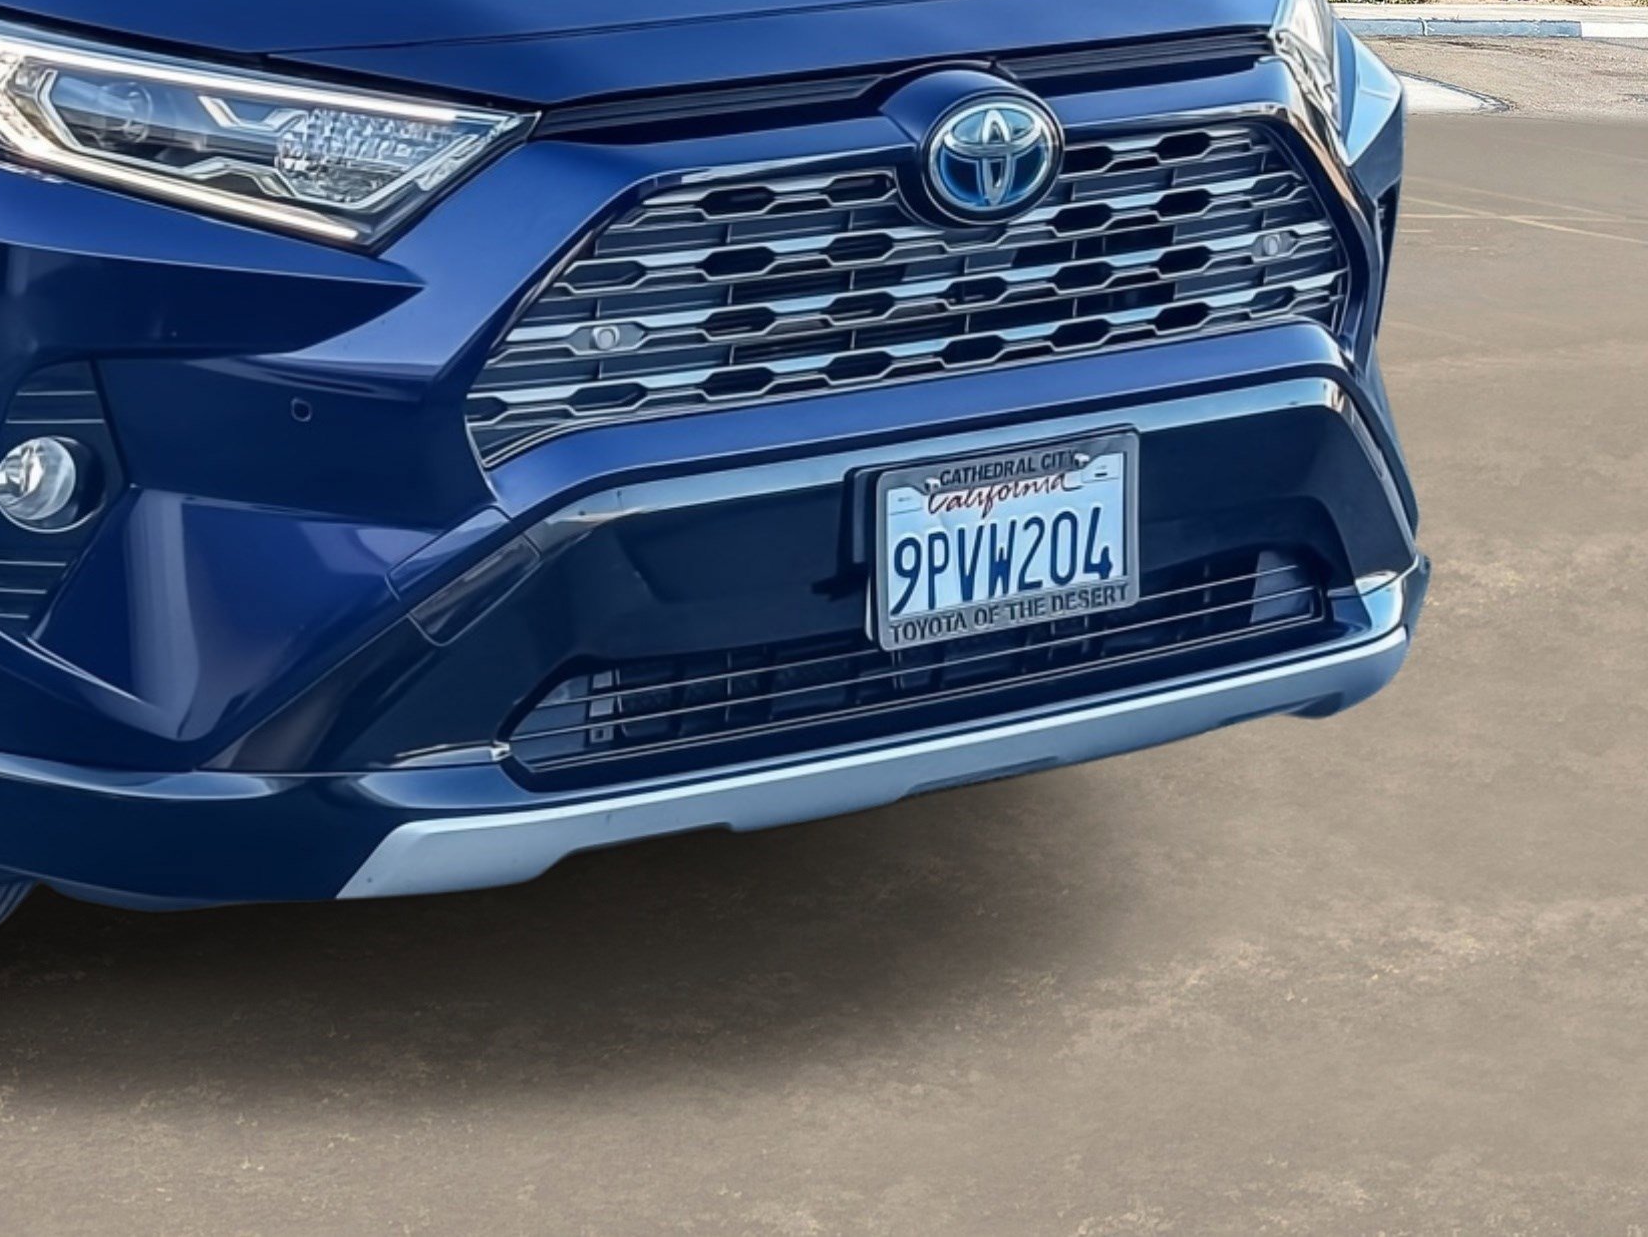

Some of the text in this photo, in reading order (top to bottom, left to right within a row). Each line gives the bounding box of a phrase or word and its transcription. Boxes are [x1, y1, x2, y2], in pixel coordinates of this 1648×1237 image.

[939, 450, 1078, 487] CATHEDRAL CITY
[928, 473, 1084, 518] California
[890, 506, 1114, 616] 9PVW204
[890, 584, 1129, 645] TOYOTA OF THE DESERT
